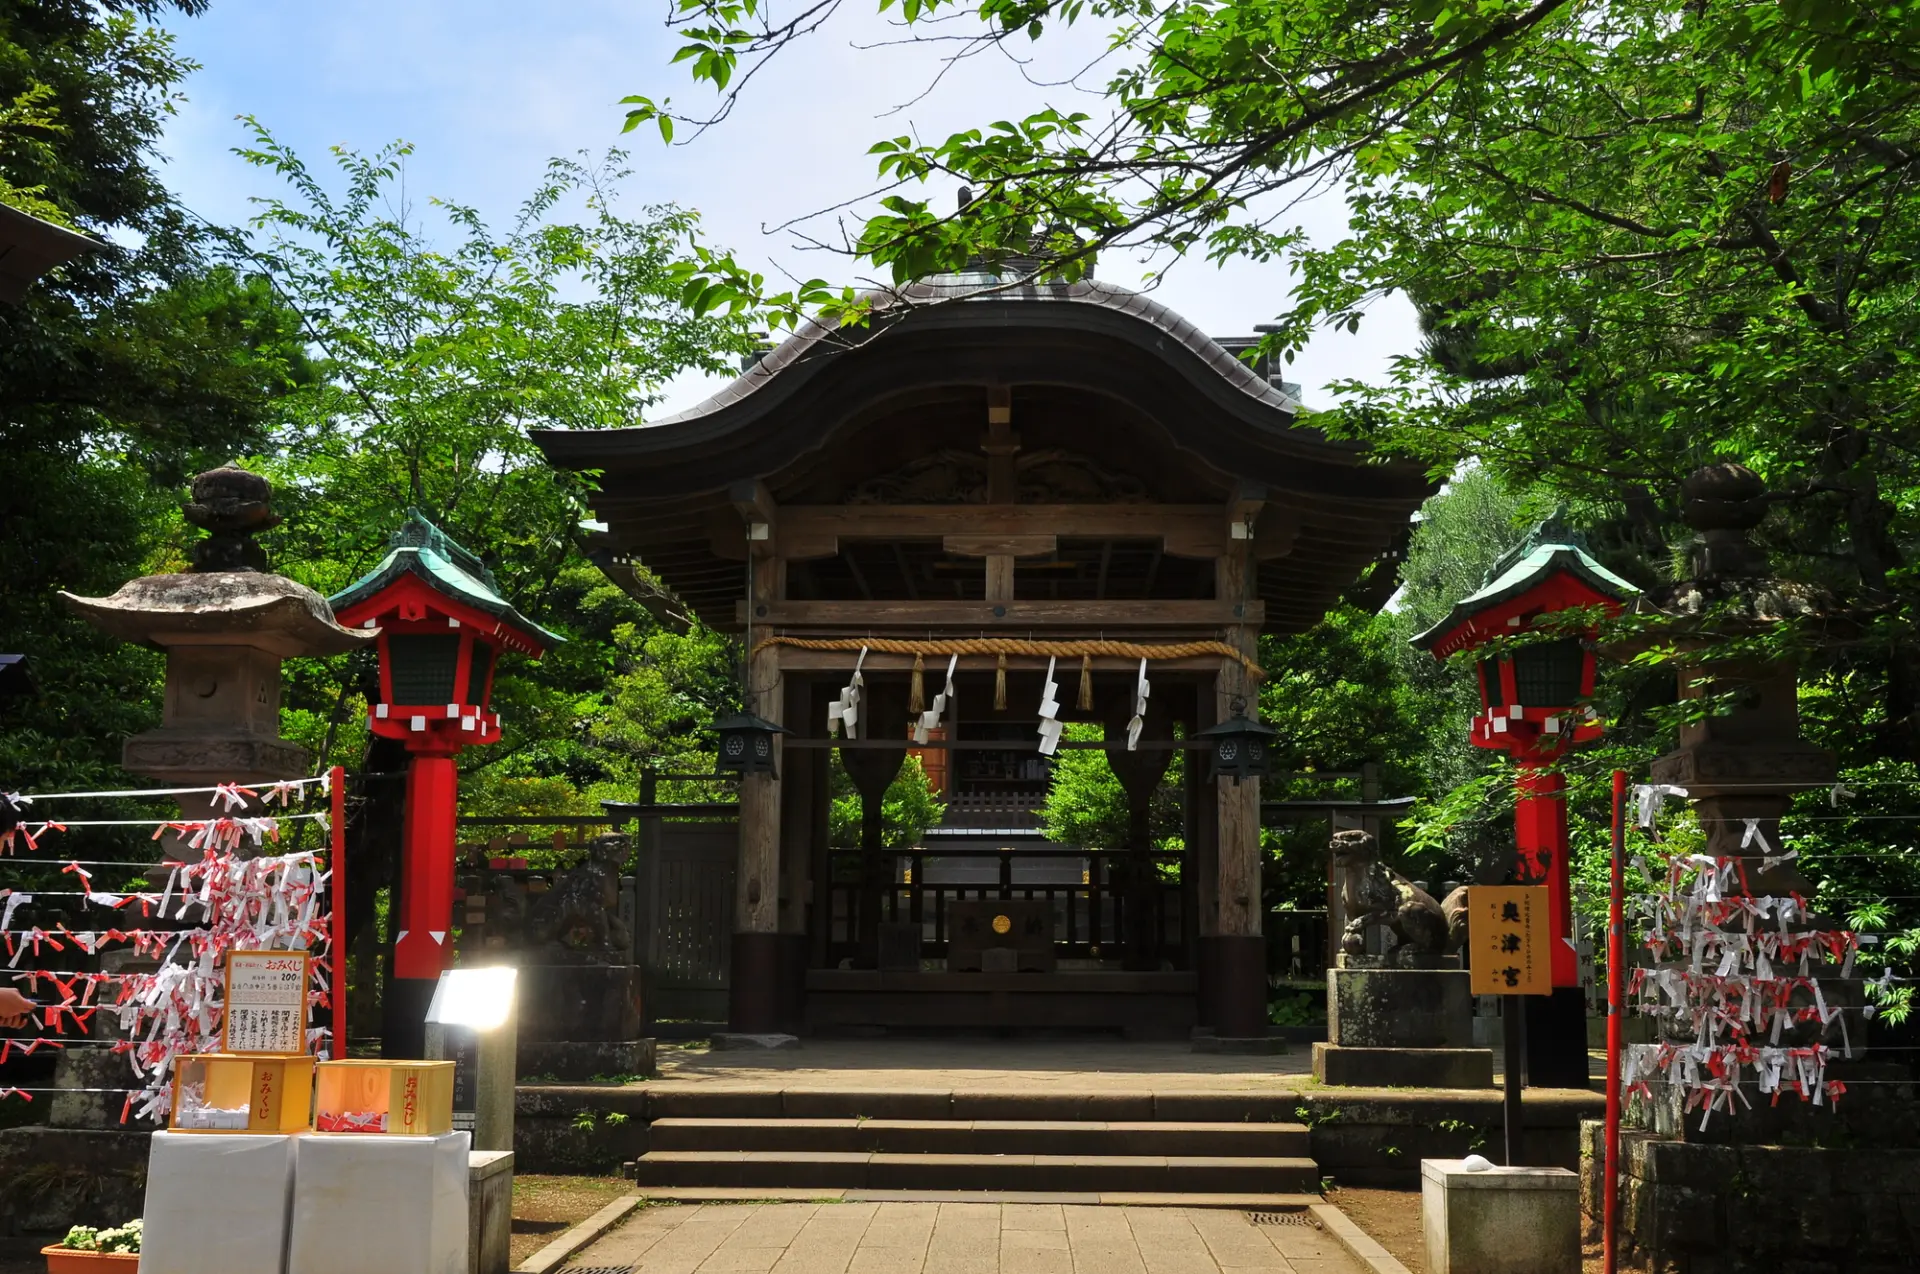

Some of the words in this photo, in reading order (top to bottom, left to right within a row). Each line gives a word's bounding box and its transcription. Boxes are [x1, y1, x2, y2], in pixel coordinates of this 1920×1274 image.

[265, 959, 302, 972] おみくじ
[1501, 900, 1521, 987] 奥津宮
[259, 1071, 273, 1120] おみくじ
[403, 1076, 418, 1126] おみくじ
